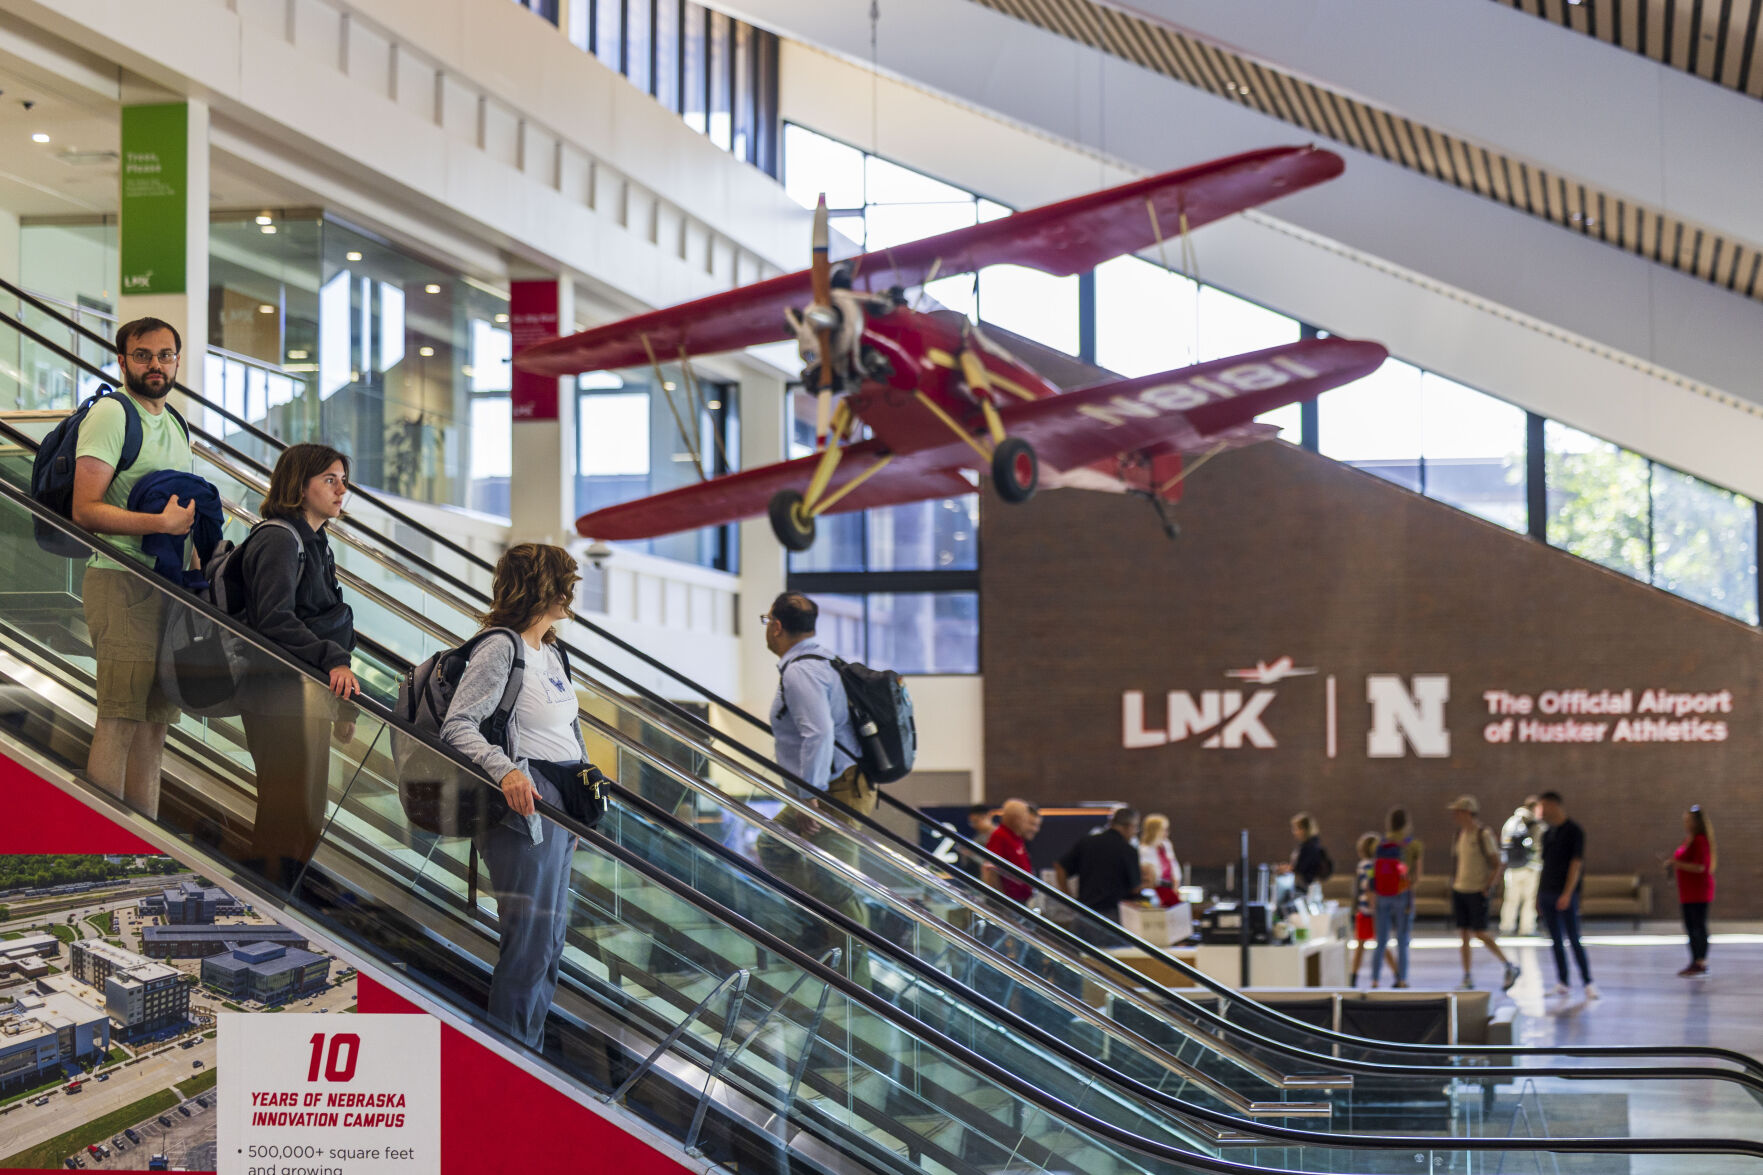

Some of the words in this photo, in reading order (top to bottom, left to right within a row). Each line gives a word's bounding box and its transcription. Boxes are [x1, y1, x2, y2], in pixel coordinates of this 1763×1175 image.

[1076, 355, 1318, 428] N8181
[1366, 673, 1451, 758] N
[1484, 689, 1532, 715] The
[1538, 688, 1633, 715] Official
[1637, 688, 1732, 717] Airport
[1122, 689, 1277, 750] LNK
[1484, 718, 1513, 744] of
[1518, 718, 1607, 744] Husker
[1611, 717, 1729, 743] Athletics
[307, 1033, 360, 1082] 10
[251, 1092, 299, 1107] YEARS
[303, 1092, 323, 1107] OF
[327, 1093, 406, 1108] NEBRASKA
[252, 1112, 339, 1127] INNOVATION
[343, 1113, 405, 1128] CAMPUS
[248, 1145, 324, 1160] 500,000+
[329, 1148, 380, 1161] square
[385, 1146, 414, 1160] feet
[248, 1164, 276, 1175] and
[281, 1164, 343, 1175] growing
